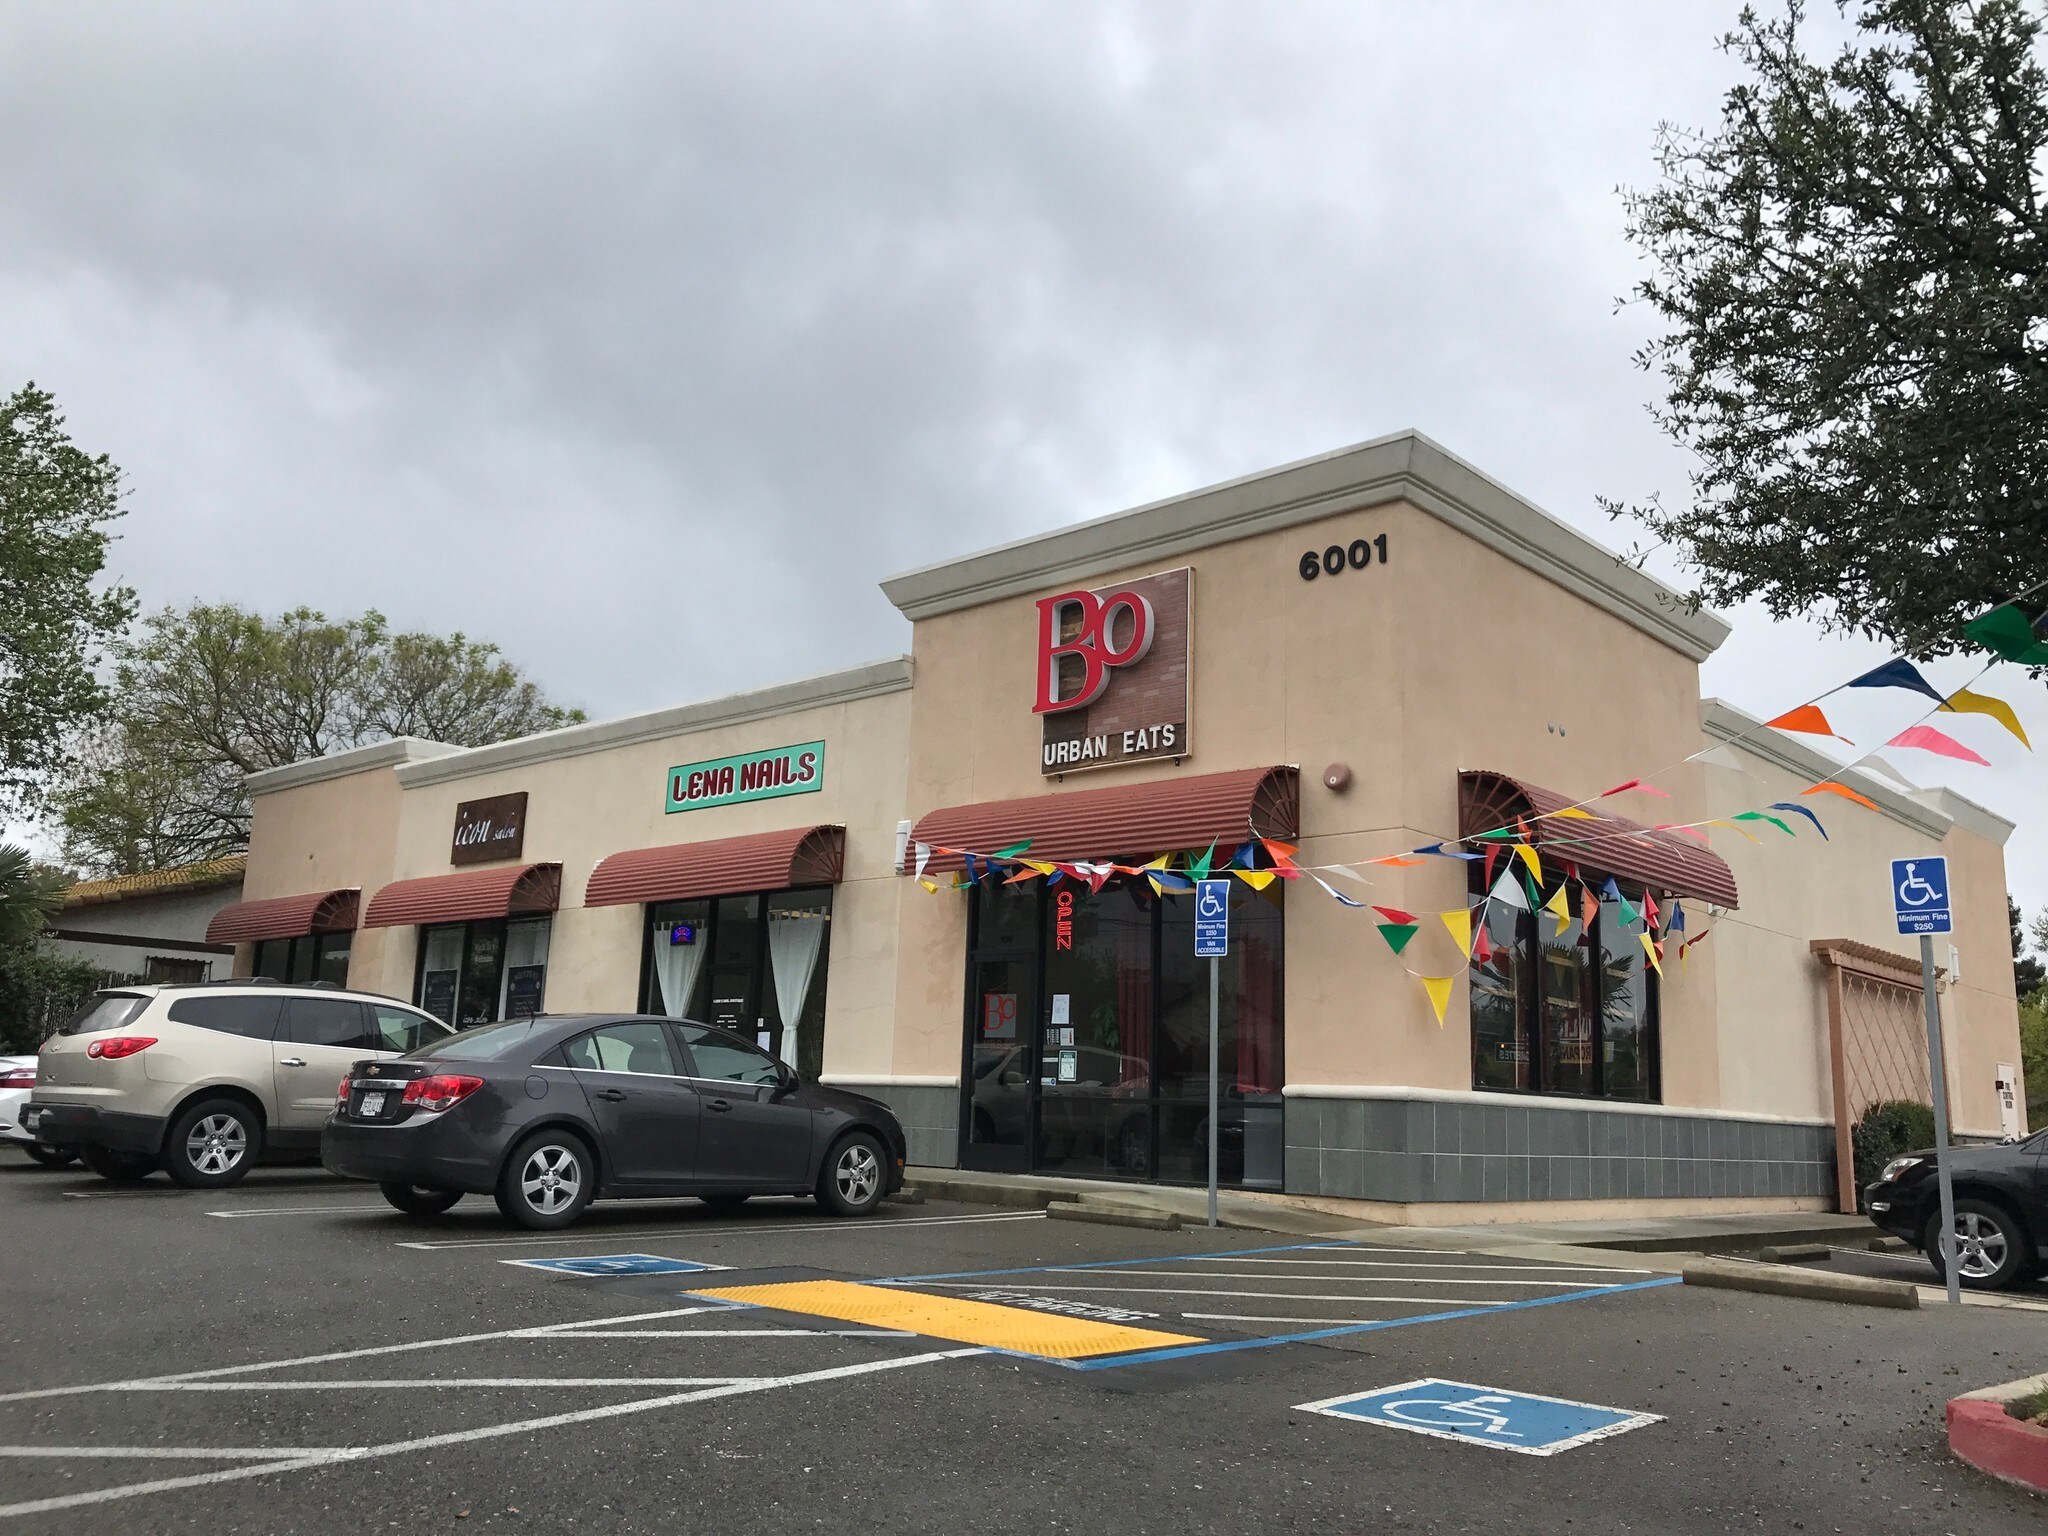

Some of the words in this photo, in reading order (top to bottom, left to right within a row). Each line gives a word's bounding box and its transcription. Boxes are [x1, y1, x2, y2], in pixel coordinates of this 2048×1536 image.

[1299, 533, 1388, 581] 6001
[1043, 734, 1108, 766] URBAN
[1122, 723, 1176, 754] EATS
[672, 765, 735, 804] LENA
[739, 752, 817, 793] NAILS
[1056, 891, 1073, 950] OPEN
[1897, 914, 1930, 922] Minimum
[1932, 913, 1948, 921] Fine
[1913, 922, 1934, 931] $250
